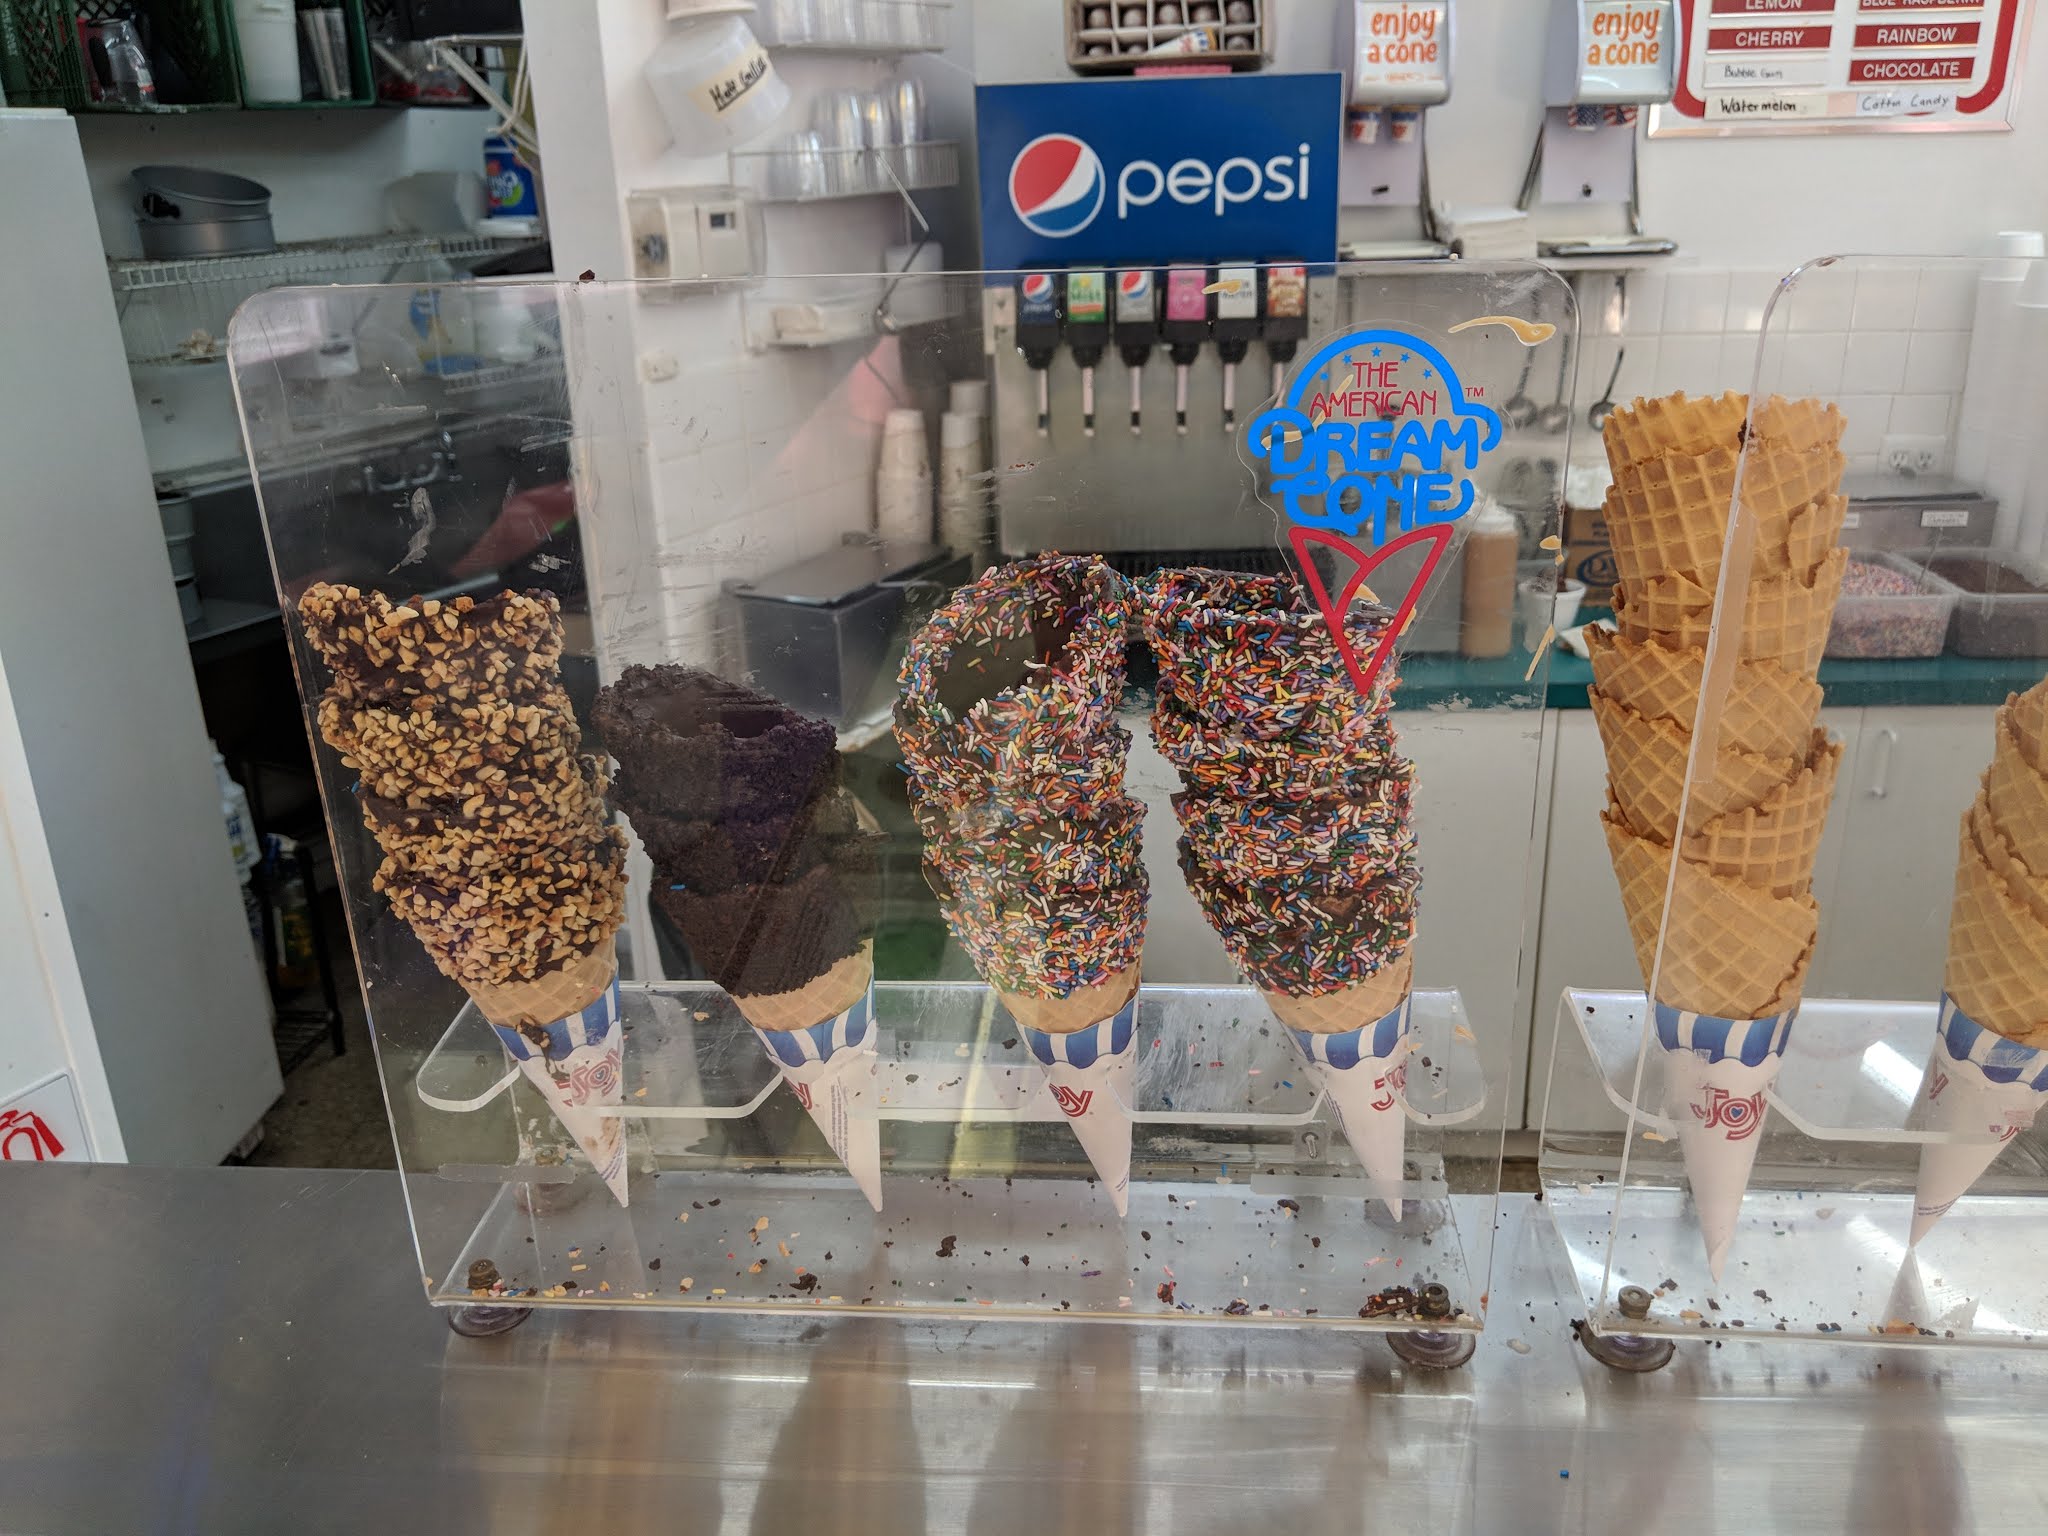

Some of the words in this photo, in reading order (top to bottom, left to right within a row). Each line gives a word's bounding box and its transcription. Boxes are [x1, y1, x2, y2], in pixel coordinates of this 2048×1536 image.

[1371, 3, 1437, 41] enjoy
[1593, 3, 1660, 42] enjoy
[1876, 26, 1957, 43] RAINBOW
[1735, 30, 1804, 47] CHERRY
[1368, 43, 1380, 63] a
[1385, 41, 1437, 64] cone
[1587, 44, 1600, 66] a
[1605, 41, 1659, 66] cone
[1863, 62, 1960, 78] CHOCOLATE
[1118, 142, 1310, 219] pepsi
[1352, 361, 1399, 388] THE
[1308, 389, 1438, 418] AMERICAN
[1247, 408, 1479, 475] DREAM
